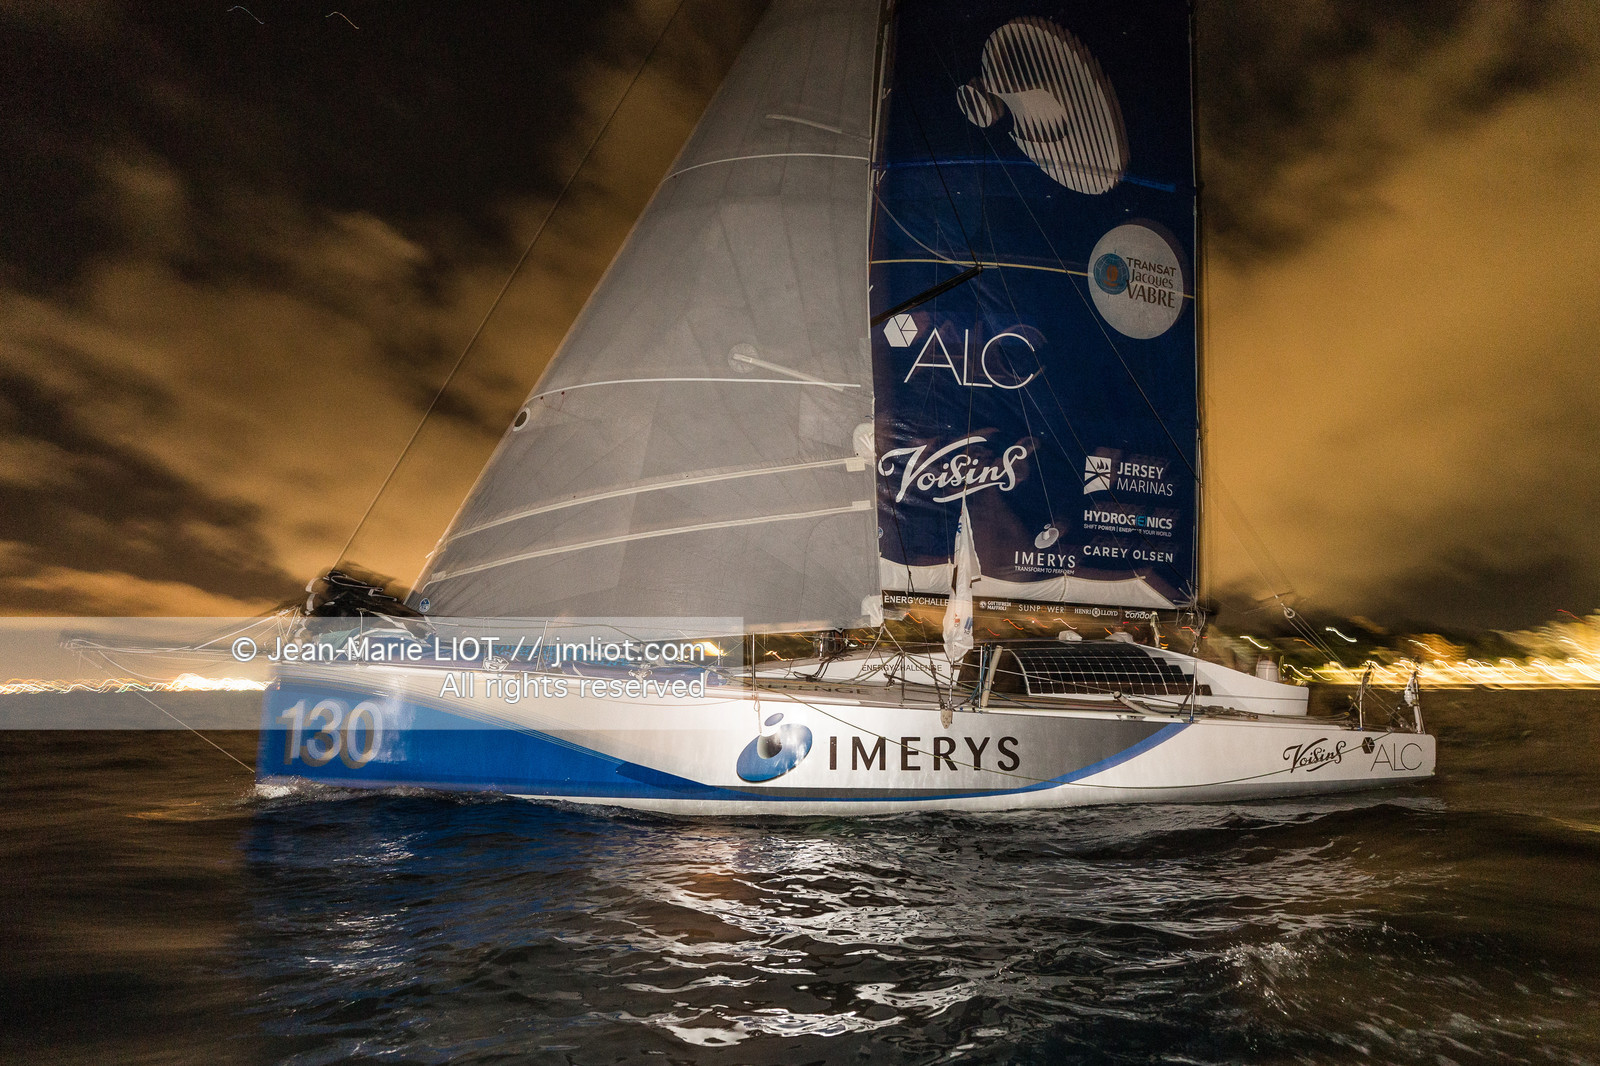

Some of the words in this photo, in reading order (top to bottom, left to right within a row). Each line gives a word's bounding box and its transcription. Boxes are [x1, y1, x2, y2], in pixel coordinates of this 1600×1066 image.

[1126, 257, 1176, 277] TRANSAT
[1130, 269, 1173, 289] Jacques
[1126, 280, 1175, 308] VABRE
[904, 328, 1035, 389] ALC
[878, 436, 1027, 503] Voisins
[1117, 462, 1163, 479] JERSEY
[1117, 478, 1173, 496] MARINAS
[1015, 551, 1076, 569] IMERYS
[1083, 545, 1128, 558] CAREY
[1133, 550, 1173, 562] OLSEN
[884, 596, 949, 607] ENERGYCHALLE
[1018, 604, 1065, 614] SUNPOWER
[276, 697, 384, 769] 130
[828, 735, 1021, 772] IMERYS
[1283, 737, 1347, 774] Voisins
[1370, 742, 1423, 772] ALC
